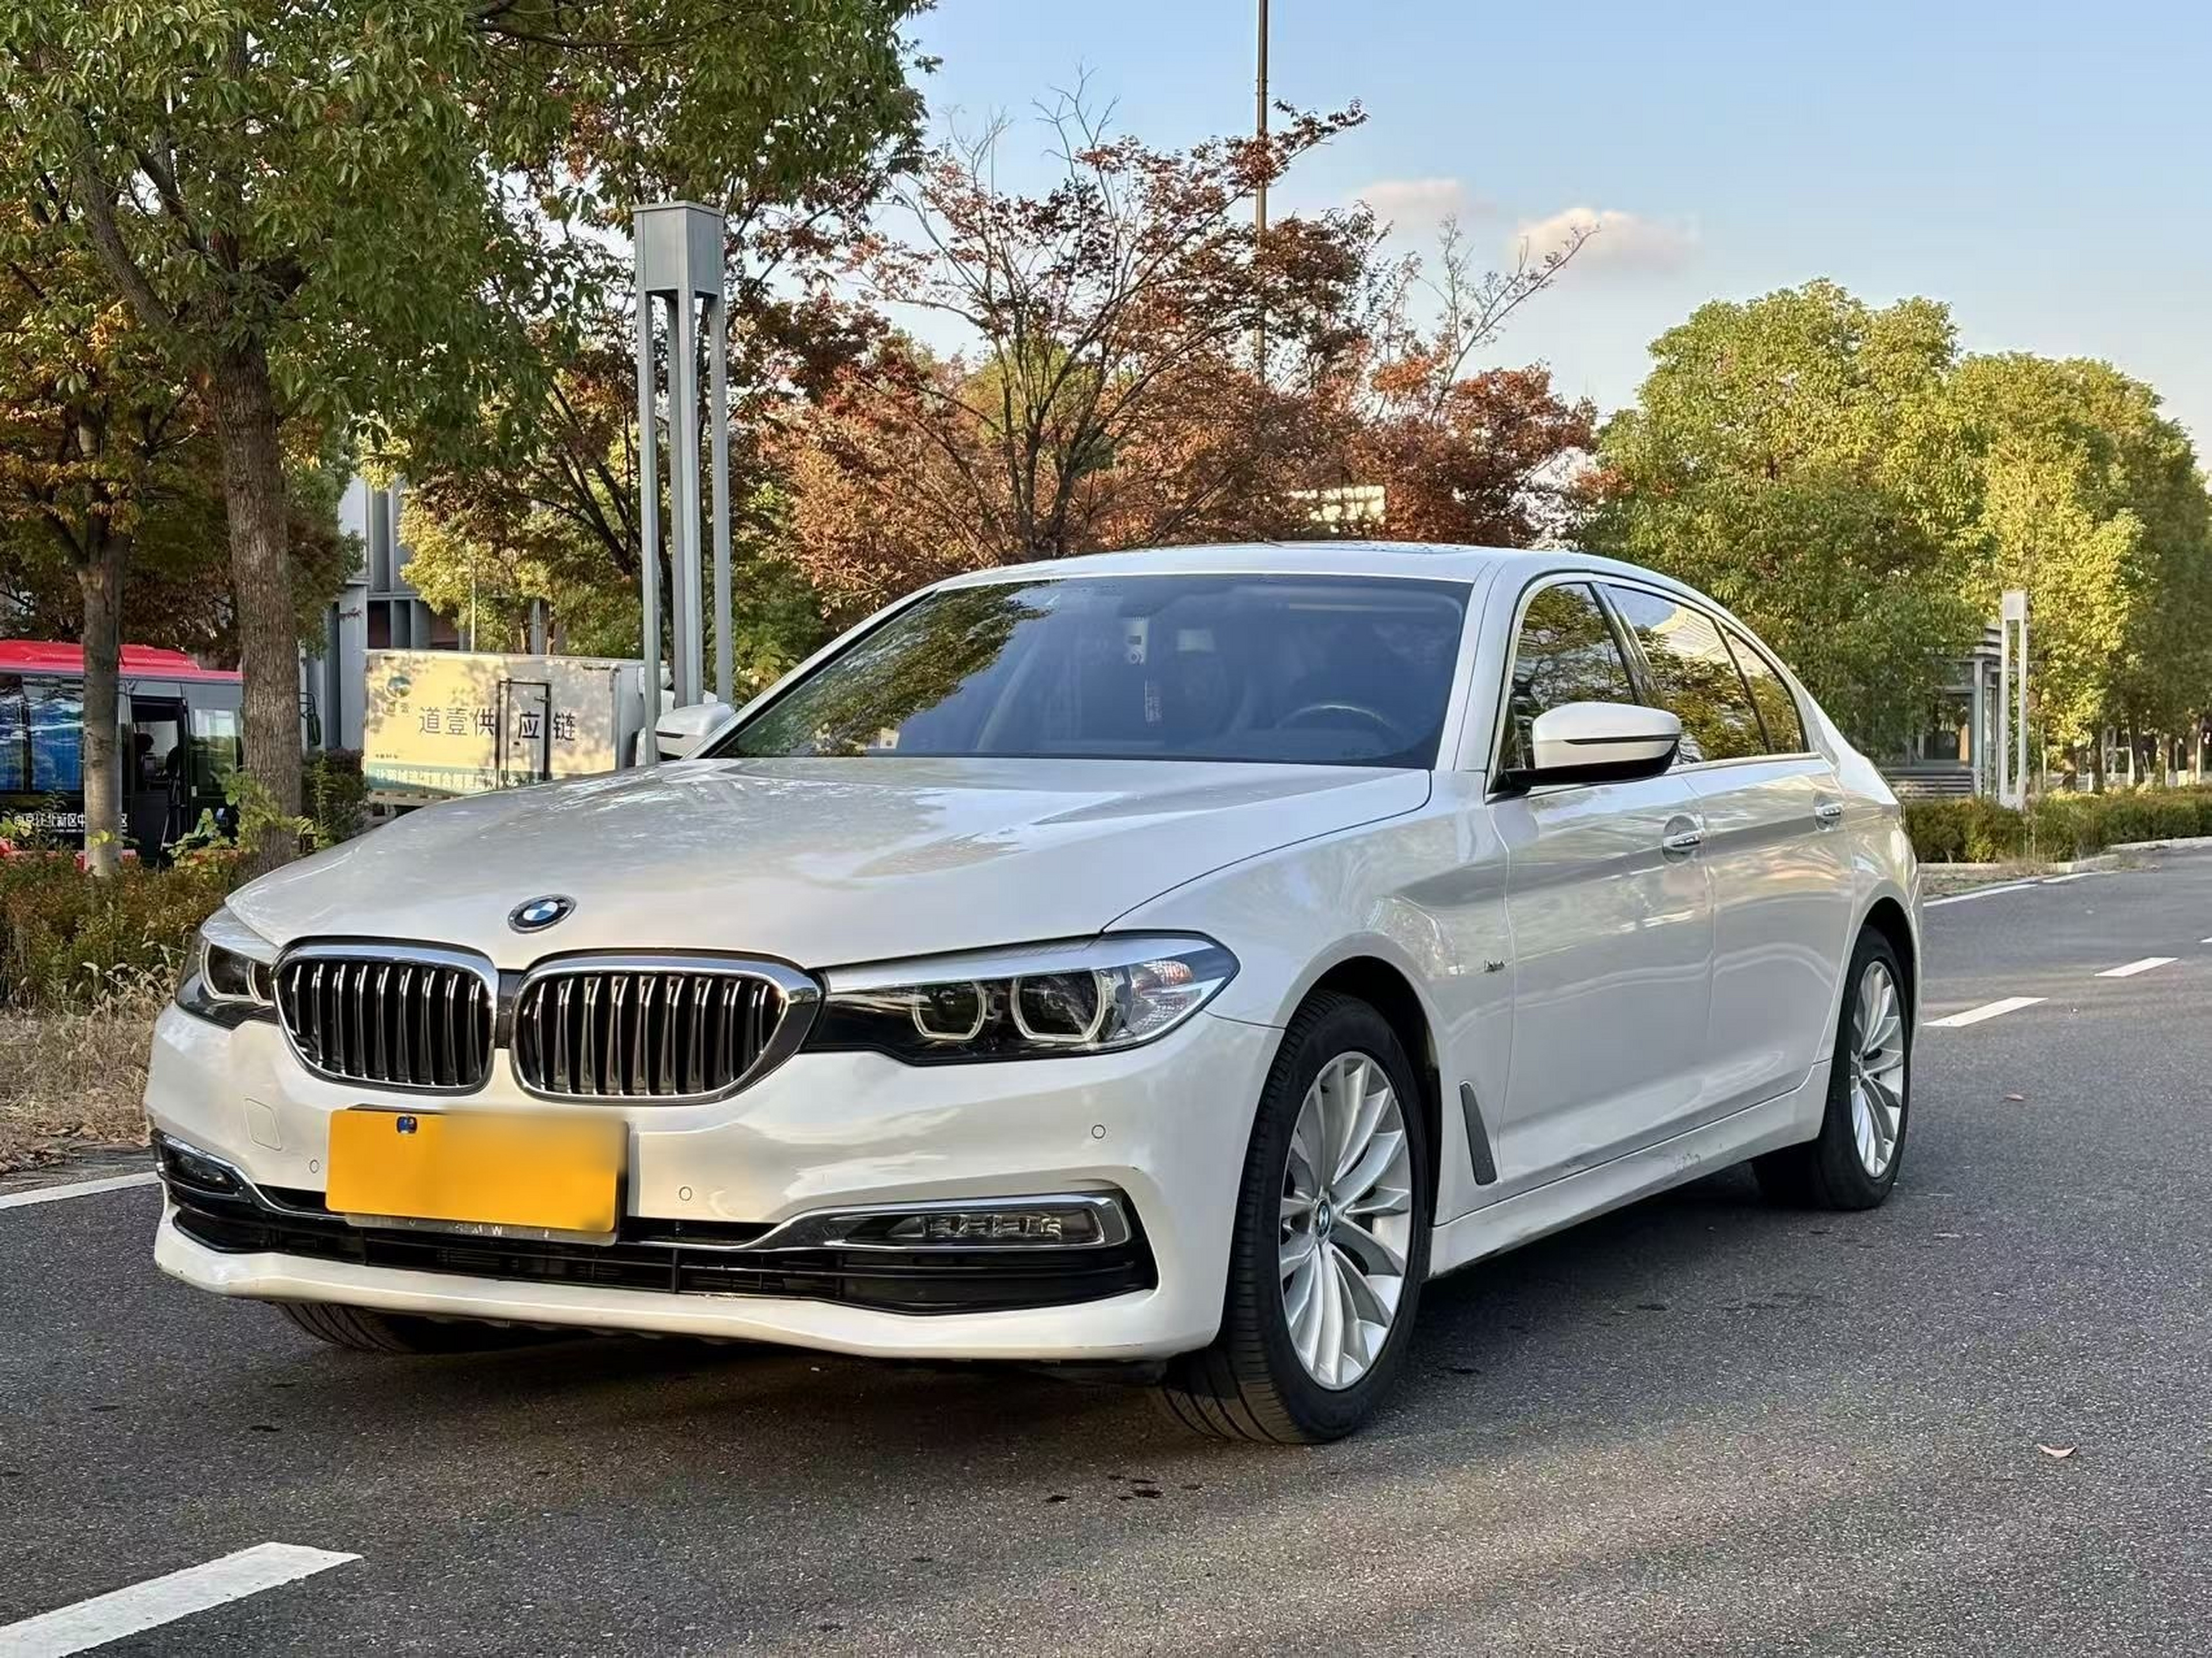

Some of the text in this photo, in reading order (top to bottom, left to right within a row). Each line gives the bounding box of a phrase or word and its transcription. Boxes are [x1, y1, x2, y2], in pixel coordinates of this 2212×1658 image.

[419, 707, 575, 741] 道壹供应链
